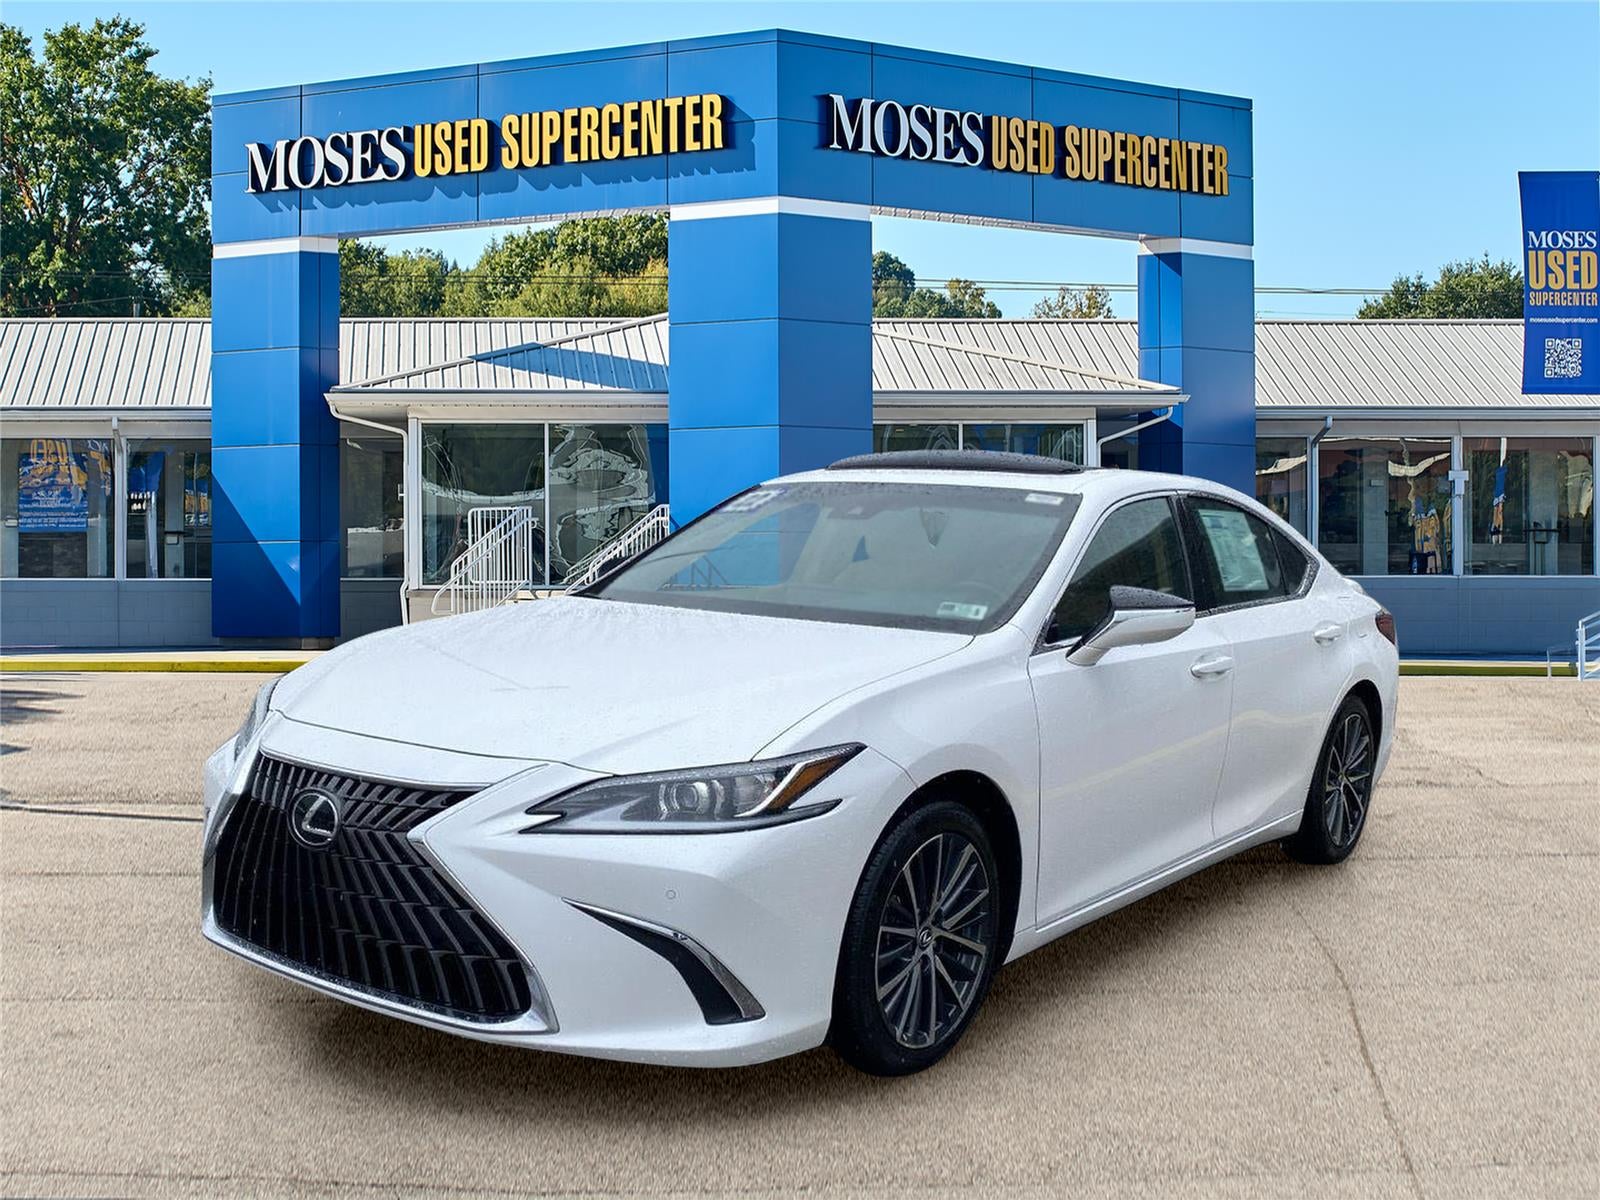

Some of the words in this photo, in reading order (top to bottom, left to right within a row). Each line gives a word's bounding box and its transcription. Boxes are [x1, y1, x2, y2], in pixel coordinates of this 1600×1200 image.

[244, 127, 406, 193] MOSES
[414, 118, 488, 178] USED
[501, 93, 724, 170] SUPERCENTER
[829, 93, 985, 167] MOSES
[991, 115, 1055, 175] USED
[1065, 125, 1229, 196] SUPERCENTER
[1528, 230, 1597, 249] MOSES
[1528, 250, 1598, 290] USED
[1529, 291, 1598, 306] SUPERCENTER
